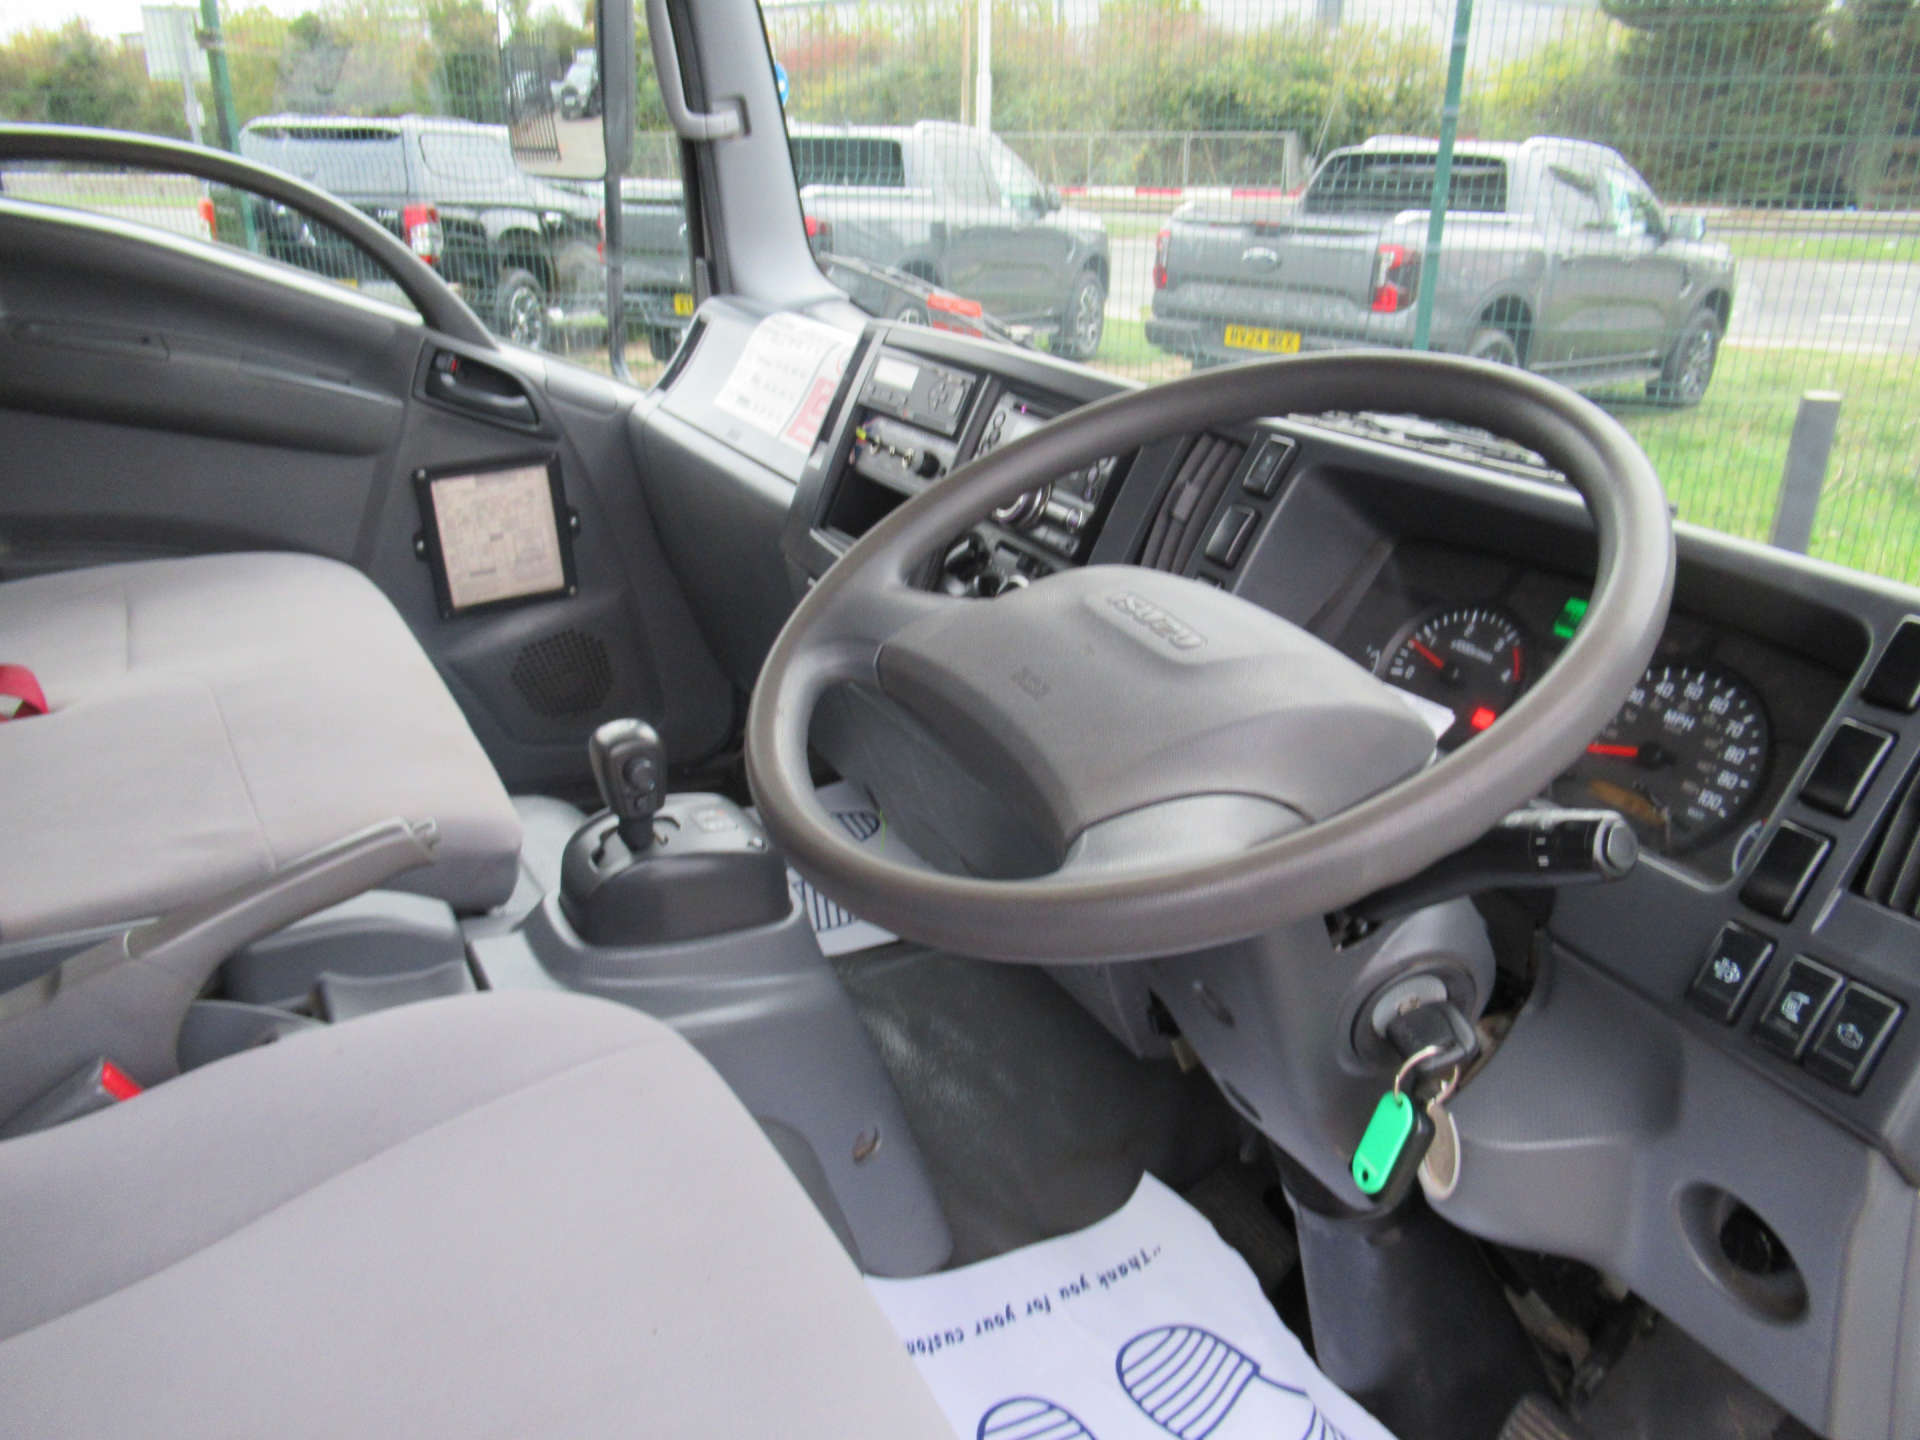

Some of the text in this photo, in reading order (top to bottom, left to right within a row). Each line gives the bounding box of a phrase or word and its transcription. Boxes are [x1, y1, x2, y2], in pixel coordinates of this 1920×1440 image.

[1654, 681, 1675, 699] 40
[1664, 708, 1696, 732] MPH
[1725, 719, 1745, 739] 70
[1724, 745, 1746, 766] 80
[1698, 788, 1723, 811] 100
[1059, 1273, 1091, 1301] you
[1026, 1294, 1052, 1315] for
[975, 1302, 1016, 1337] your
